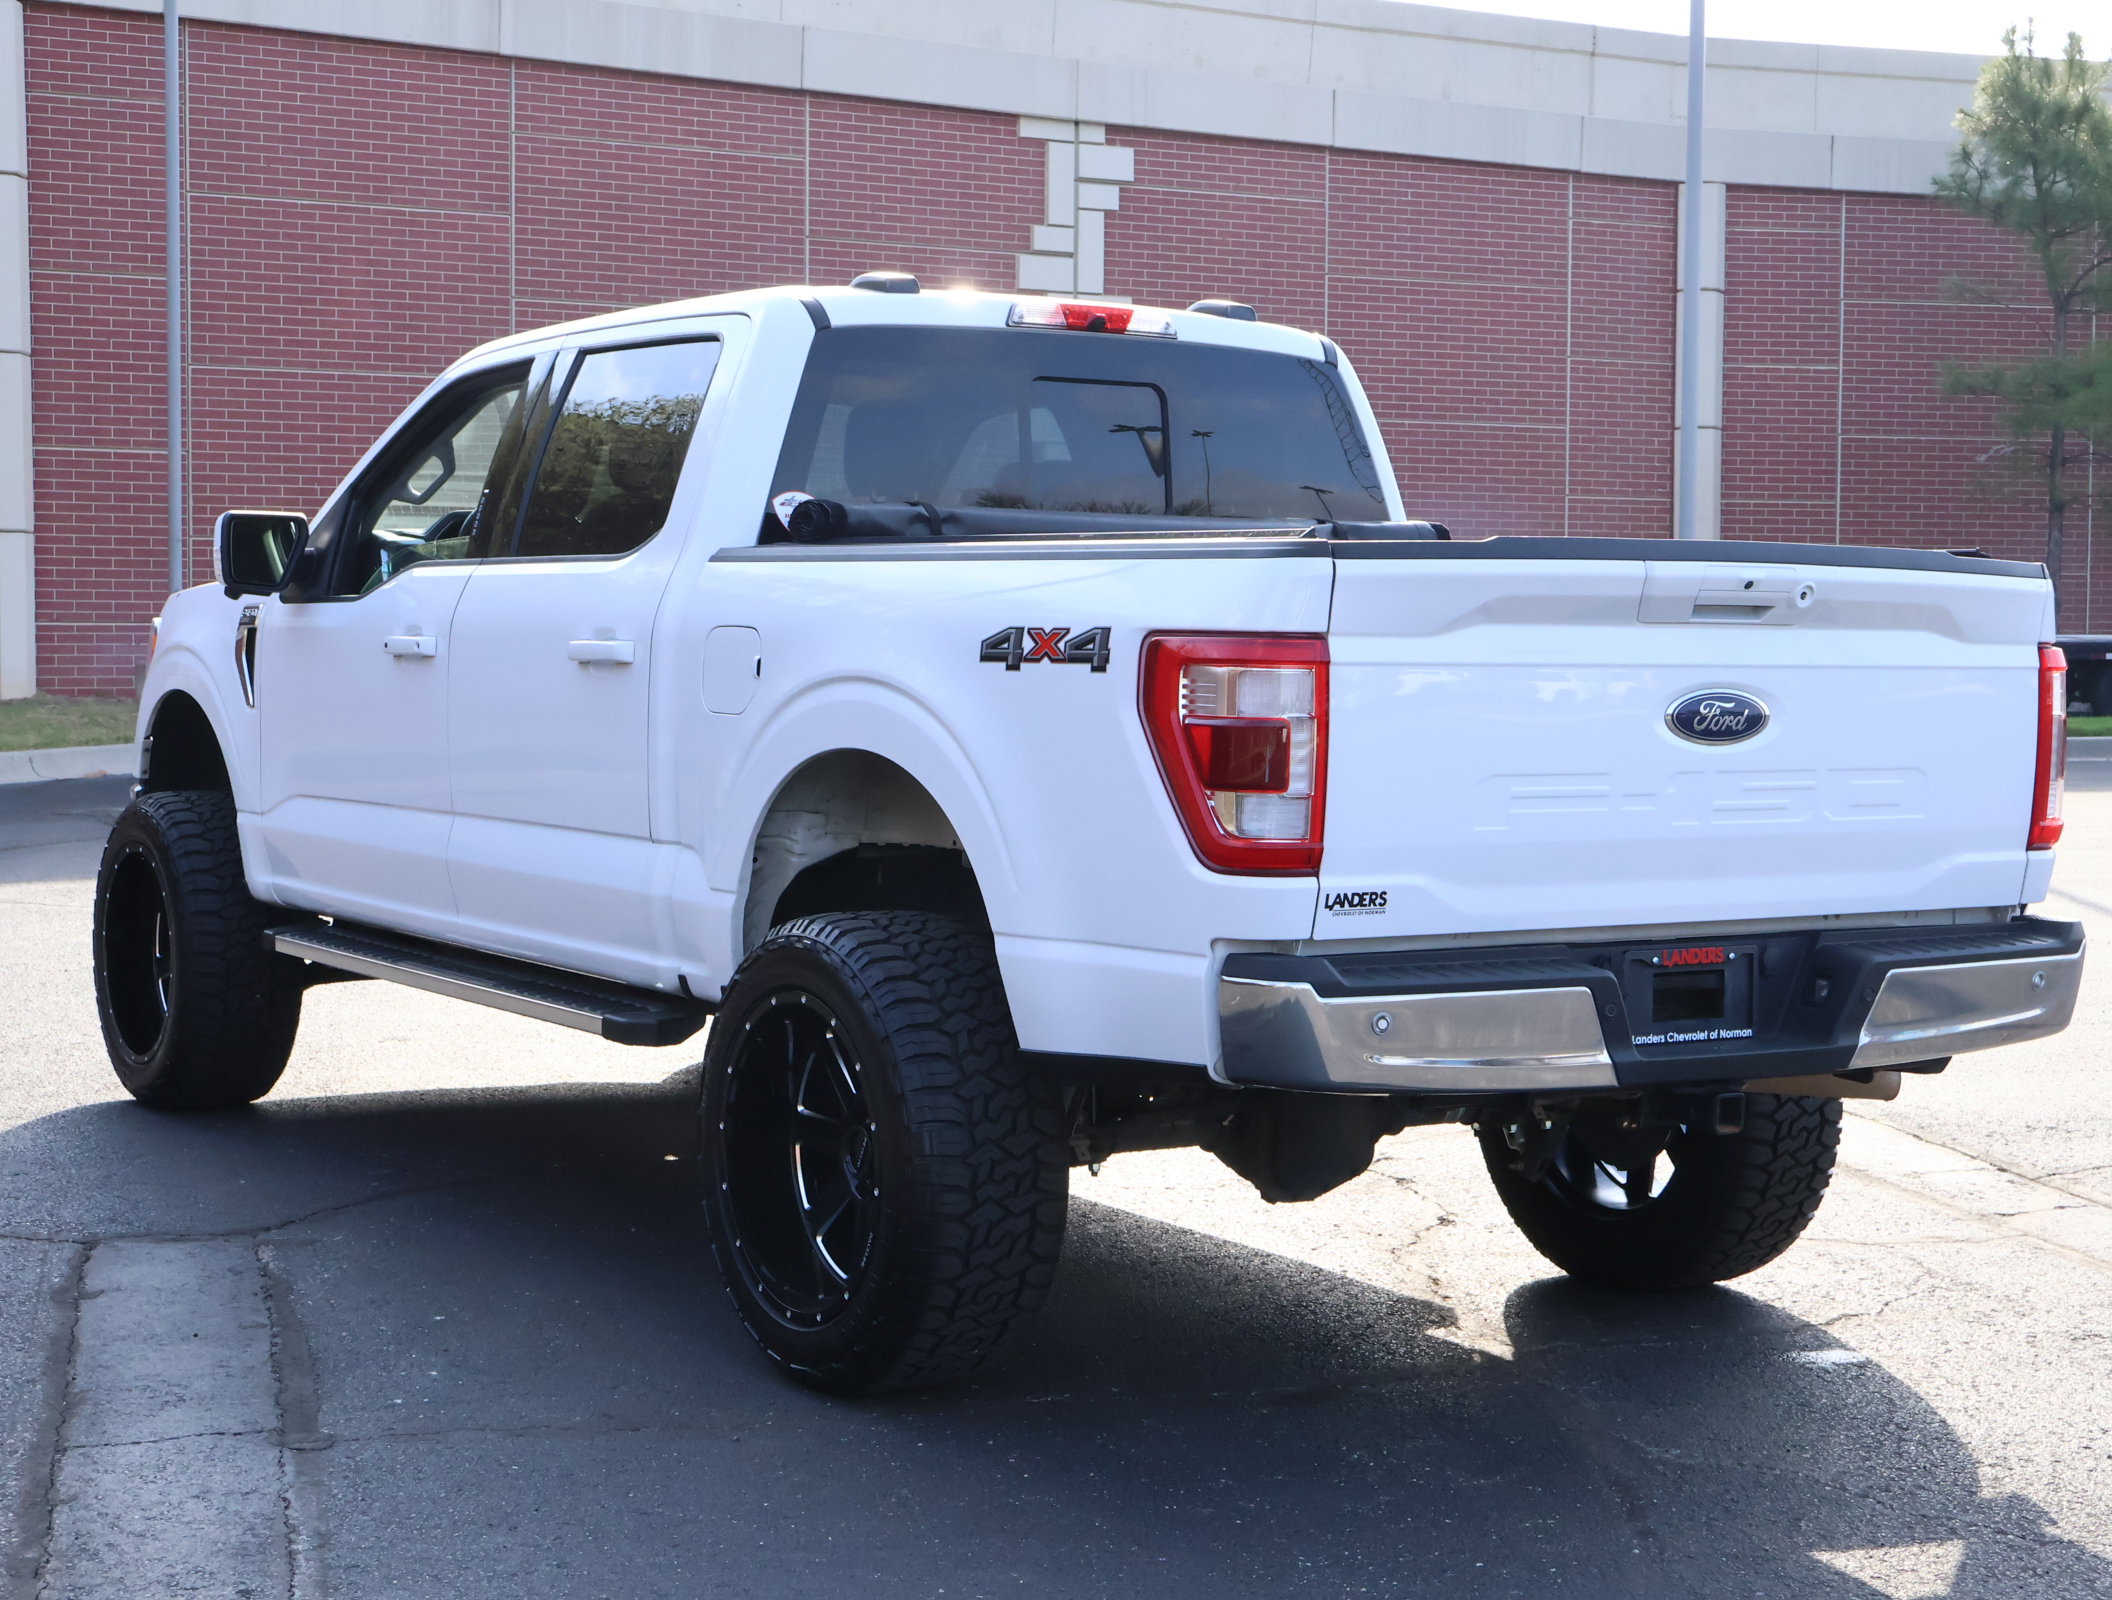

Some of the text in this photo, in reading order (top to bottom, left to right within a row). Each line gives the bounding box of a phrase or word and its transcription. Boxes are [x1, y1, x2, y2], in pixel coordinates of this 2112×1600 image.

[1693, 700, 1749, 732] Ford
[1473, 767, 1928, 831] F-150
[1324, 890, 1388, 911] LANDERS
[1662, 946, 1725, 968] LANDERS
[1631, 1028, 1753, 1045] Landers Chevrolet of Norman
